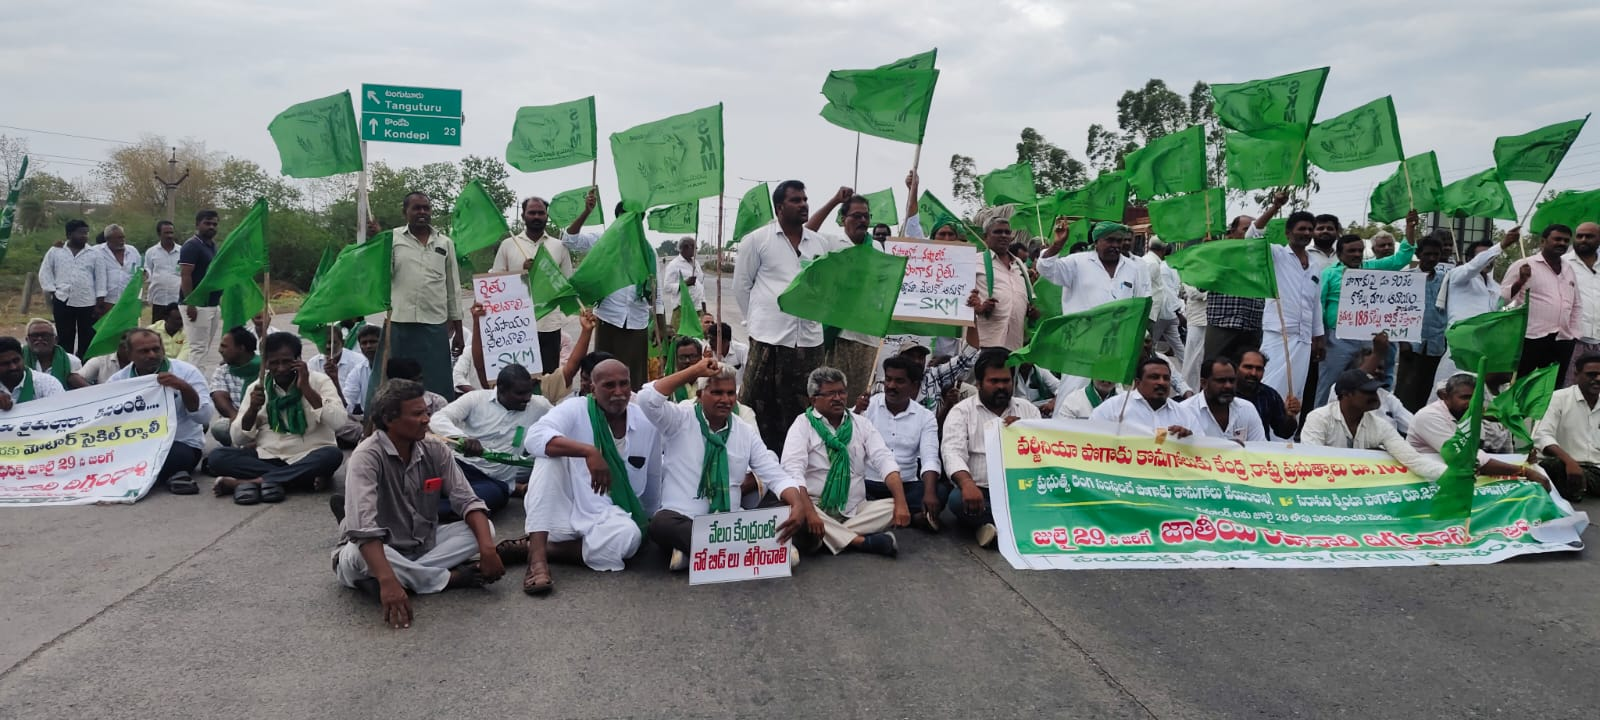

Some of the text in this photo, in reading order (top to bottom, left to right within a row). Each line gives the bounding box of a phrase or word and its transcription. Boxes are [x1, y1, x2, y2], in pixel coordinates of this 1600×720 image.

[384, 100, 442, 112] Tanguturu
[384, 127, 456, 141] Kondepi 23
[80, 425, 122, 448] సైకిల్
[58, 455, 76, 469] 29
[1081, 444, 1133, 465] పొగాకు
[708, 514, 778, 544] వేలం కేంద్రంలో
[1073, 527, 1107, 546] 29
[693, 547, 708, 572] నో
[743, 545, 788, 576] తగ్గించాలి
